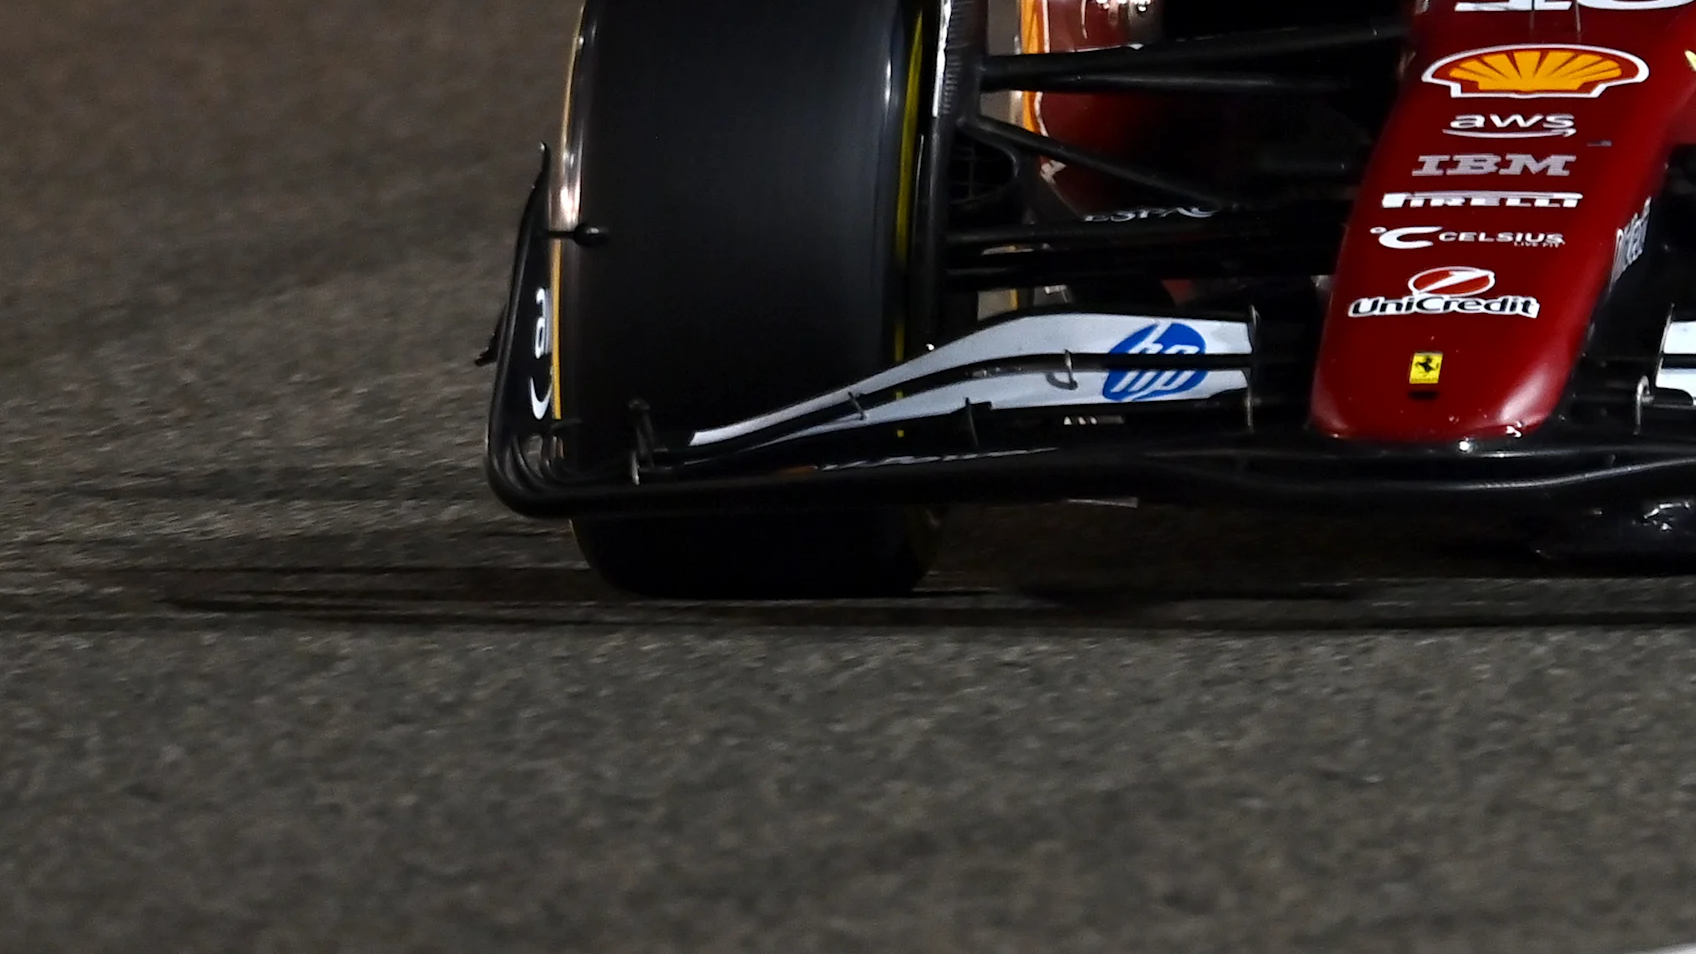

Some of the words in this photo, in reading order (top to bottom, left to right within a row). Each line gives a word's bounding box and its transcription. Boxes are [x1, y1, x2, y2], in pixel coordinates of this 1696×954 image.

[1450, 113, 1575, 129] aws
[1412, 153, 1577, 177] IBM
[1382, 190, 1583, 208] PIRELLI
[1438, 232, 1564, 244] CELSIUS
[1349, 295, 1540, 319] UniCredit
[1110, 320, 1200, 402] hp
